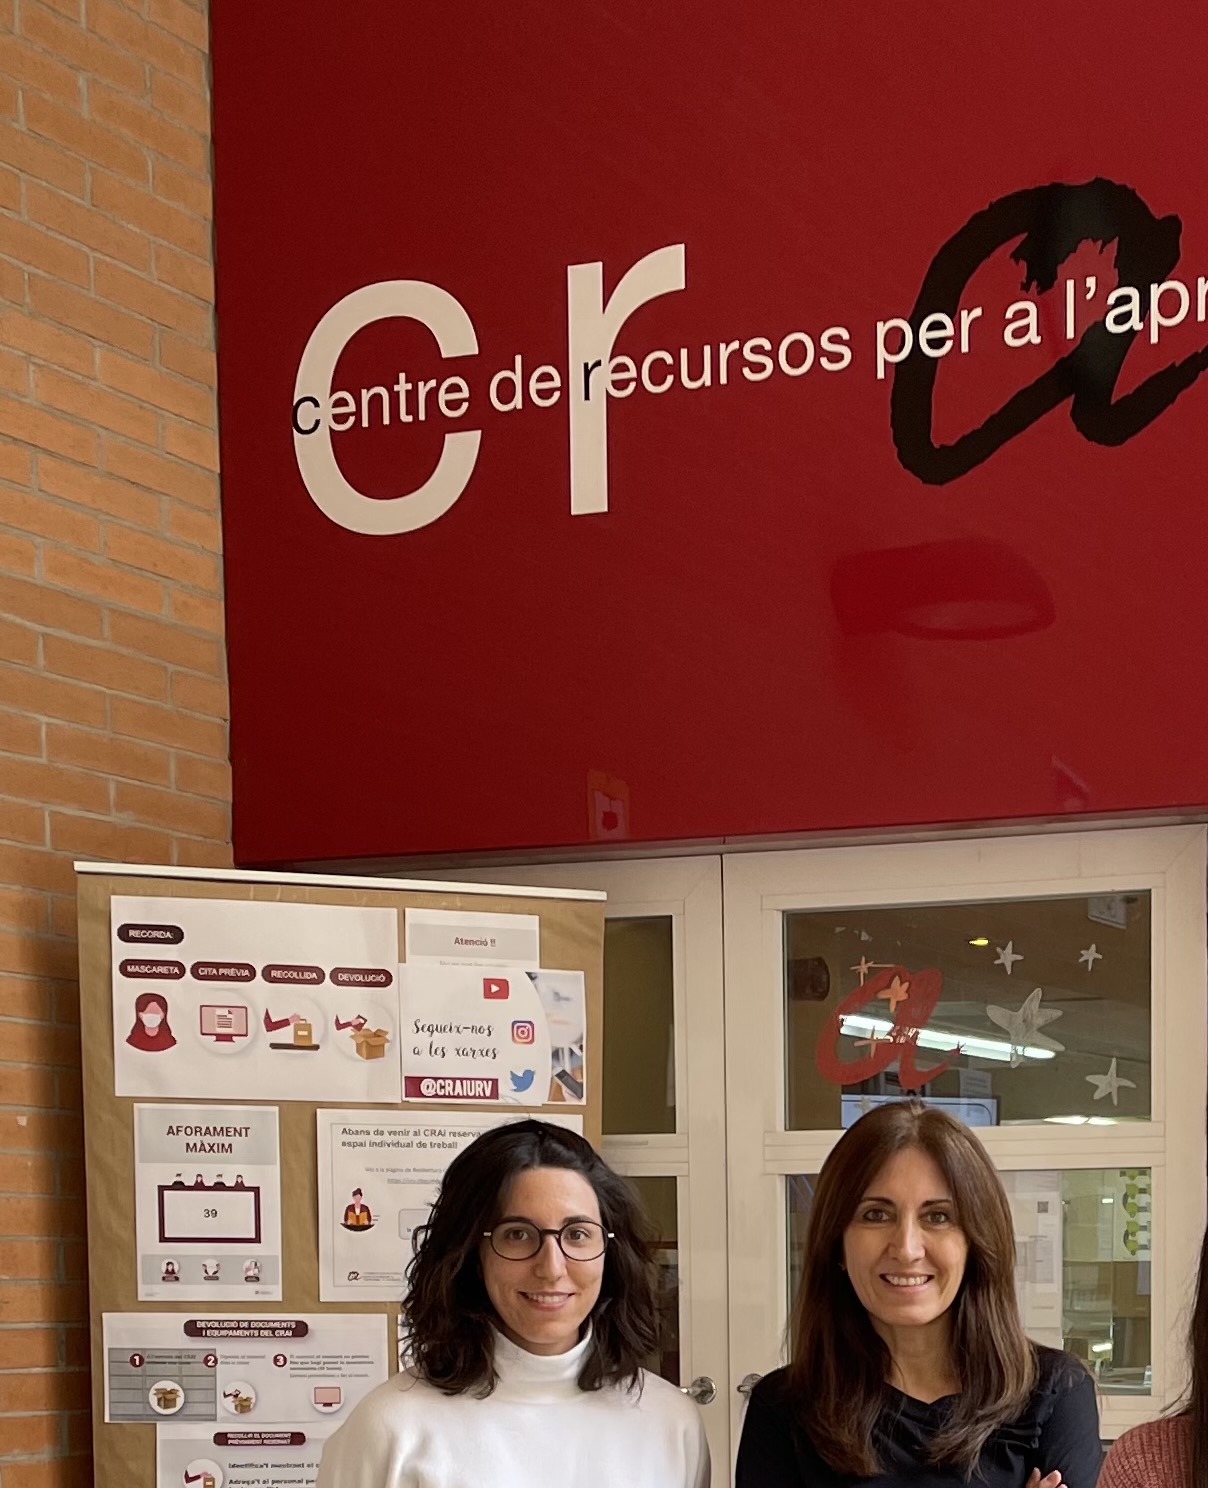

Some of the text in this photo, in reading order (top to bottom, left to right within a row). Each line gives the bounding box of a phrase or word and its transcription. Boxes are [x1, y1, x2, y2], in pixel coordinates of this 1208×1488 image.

[292, 371, 470, 435] centre
[489, 354, 562, 412] de
[582, 325, 852, 402] recursos
[876, 303, 982, 379] per
[1002, 299, 1042, 347] a
[454, 936, 489, 947] Atenció
[126, 964, 180, 975] MASCARETA
[198, 966, 218, 976] CITA
[270, 969, 318, 980] RECOLLIDA
[337, 971, 386, 983] DEVOLUCIÓ
[412, 1018, 495, 1037] Segueix-nos
[412, 1041, 499, 1060] a les xarxes
[420, 1078, 493, 1097] @CRAIURV
[166, 1125, 251, 1138] AFORAMENT
[341, 1127, 371, 1136] Abans
[373, 1128, 384, 1136] de
[387, 1128, 410, 1137] venir
[185, 1140, 233, 1154] MÀXIM
[368, 1140, 414, 1149] individual
[416, 1141, 427, 1149] de
[203, 1208, 218, 1219] 39
[133, 1355, 140, 1367] 1
[206, 1355, 215, 1367] 2
[276, 1355, 285, 1366] 3
